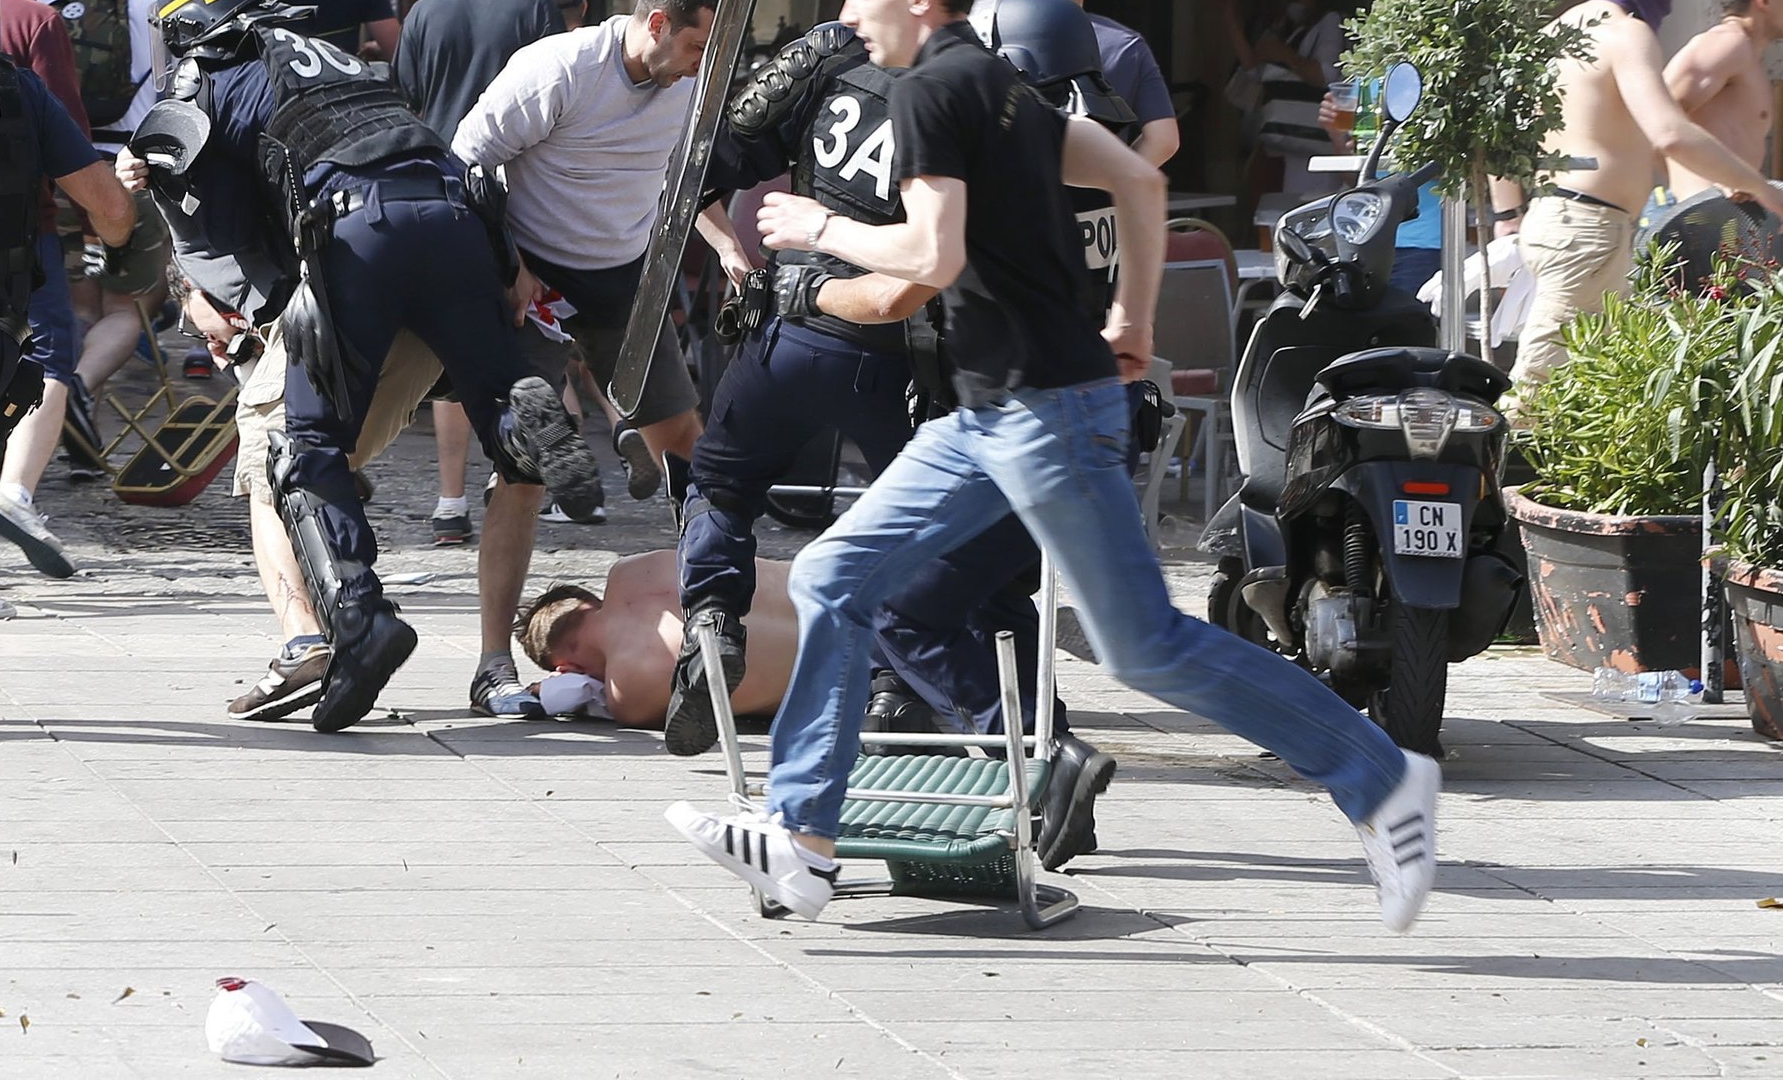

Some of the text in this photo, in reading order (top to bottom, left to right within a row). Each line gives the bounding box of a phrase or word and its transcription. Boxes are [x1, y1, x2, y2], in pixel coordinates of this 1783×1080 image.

[813, 95, 896, 201] 3A
[1419, 505, 1444, 527] CN
[1403, 529, 1457, 551] 190 X
